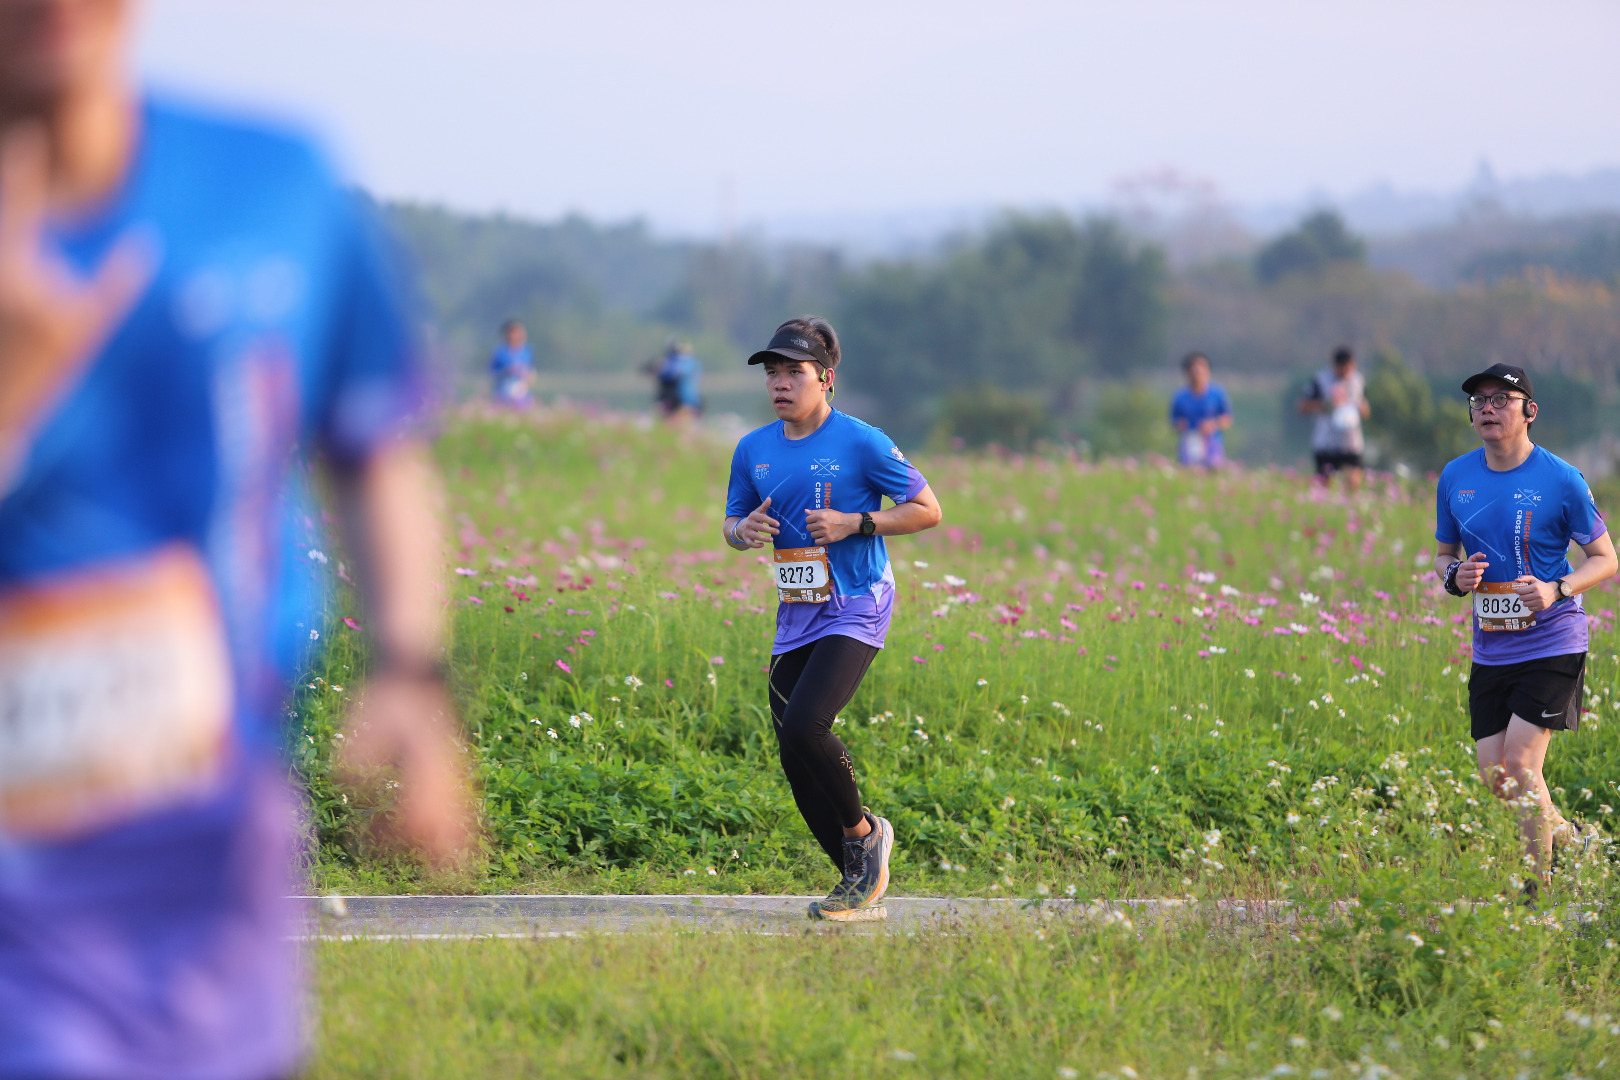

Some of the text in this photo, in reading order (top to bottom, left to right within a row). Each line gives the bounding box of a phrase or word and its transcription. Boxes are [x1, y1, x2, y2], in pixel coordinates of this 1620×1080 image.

[1514, 509, 1523, 534] CROSS
[1523, 510, 1533, 543] SINGHA
[1514, 535, 1522, 569] COUNTRY
[779, 565, 814, 584] 8273
[1482, 597, 1521, 614] 8036
